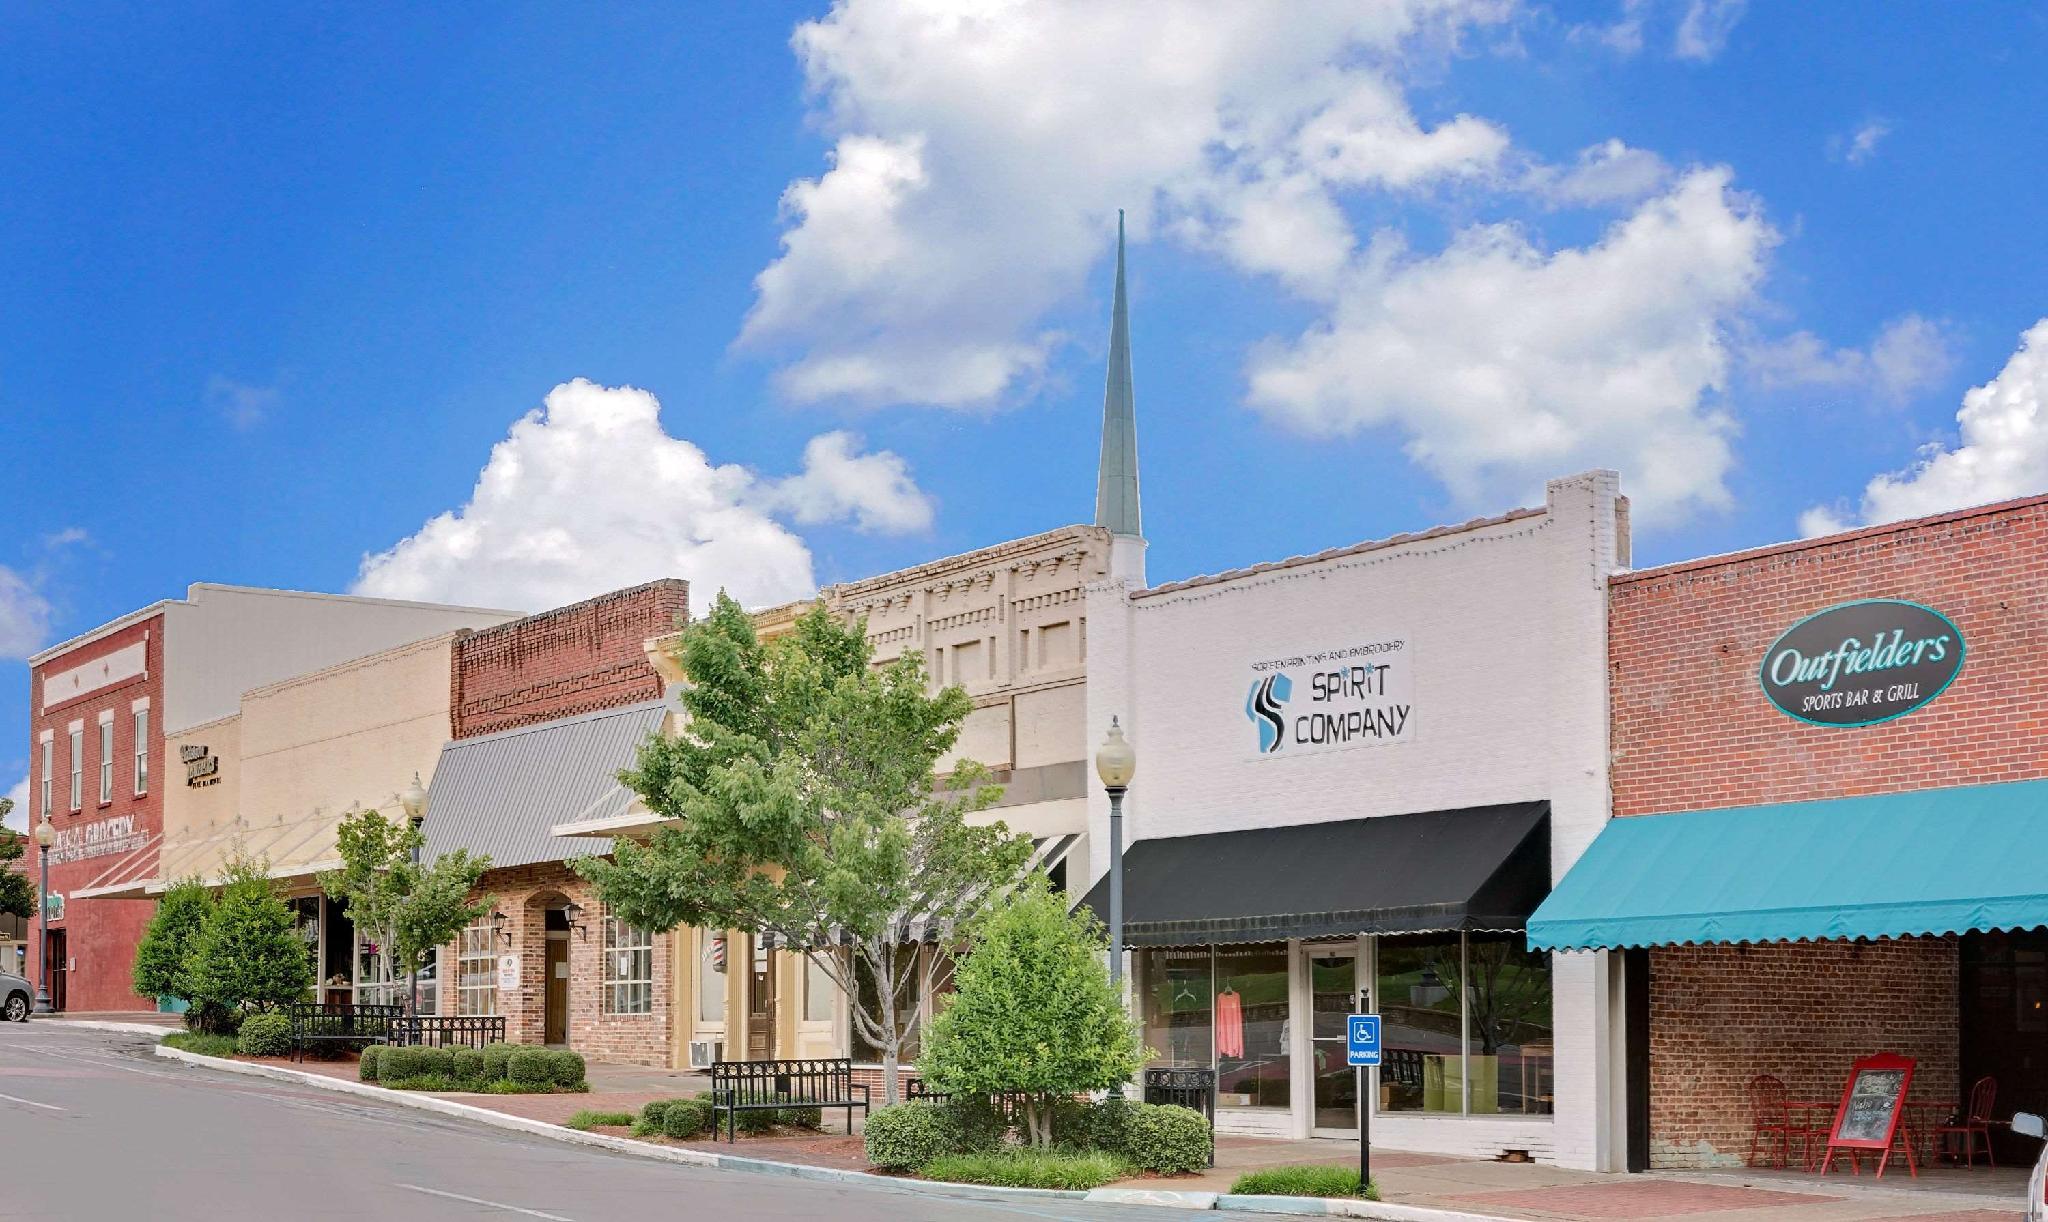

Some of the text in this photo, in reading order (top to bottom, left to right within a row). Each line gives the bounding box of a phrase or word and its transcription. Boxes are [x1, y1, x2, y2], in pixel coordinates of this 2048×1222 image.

[1328, 648, 1347, 661] AND
[1349, 640, 1405, 658] EMBROIDERY
[1770, 628, 1950, 691] Outfielders
[1801, 682, 1920, 713] SPORTS BAR & GRILL
[1295, 704, 1411, 744] COMPANY
[1350, 1050, 1379, 1059] PARKING
